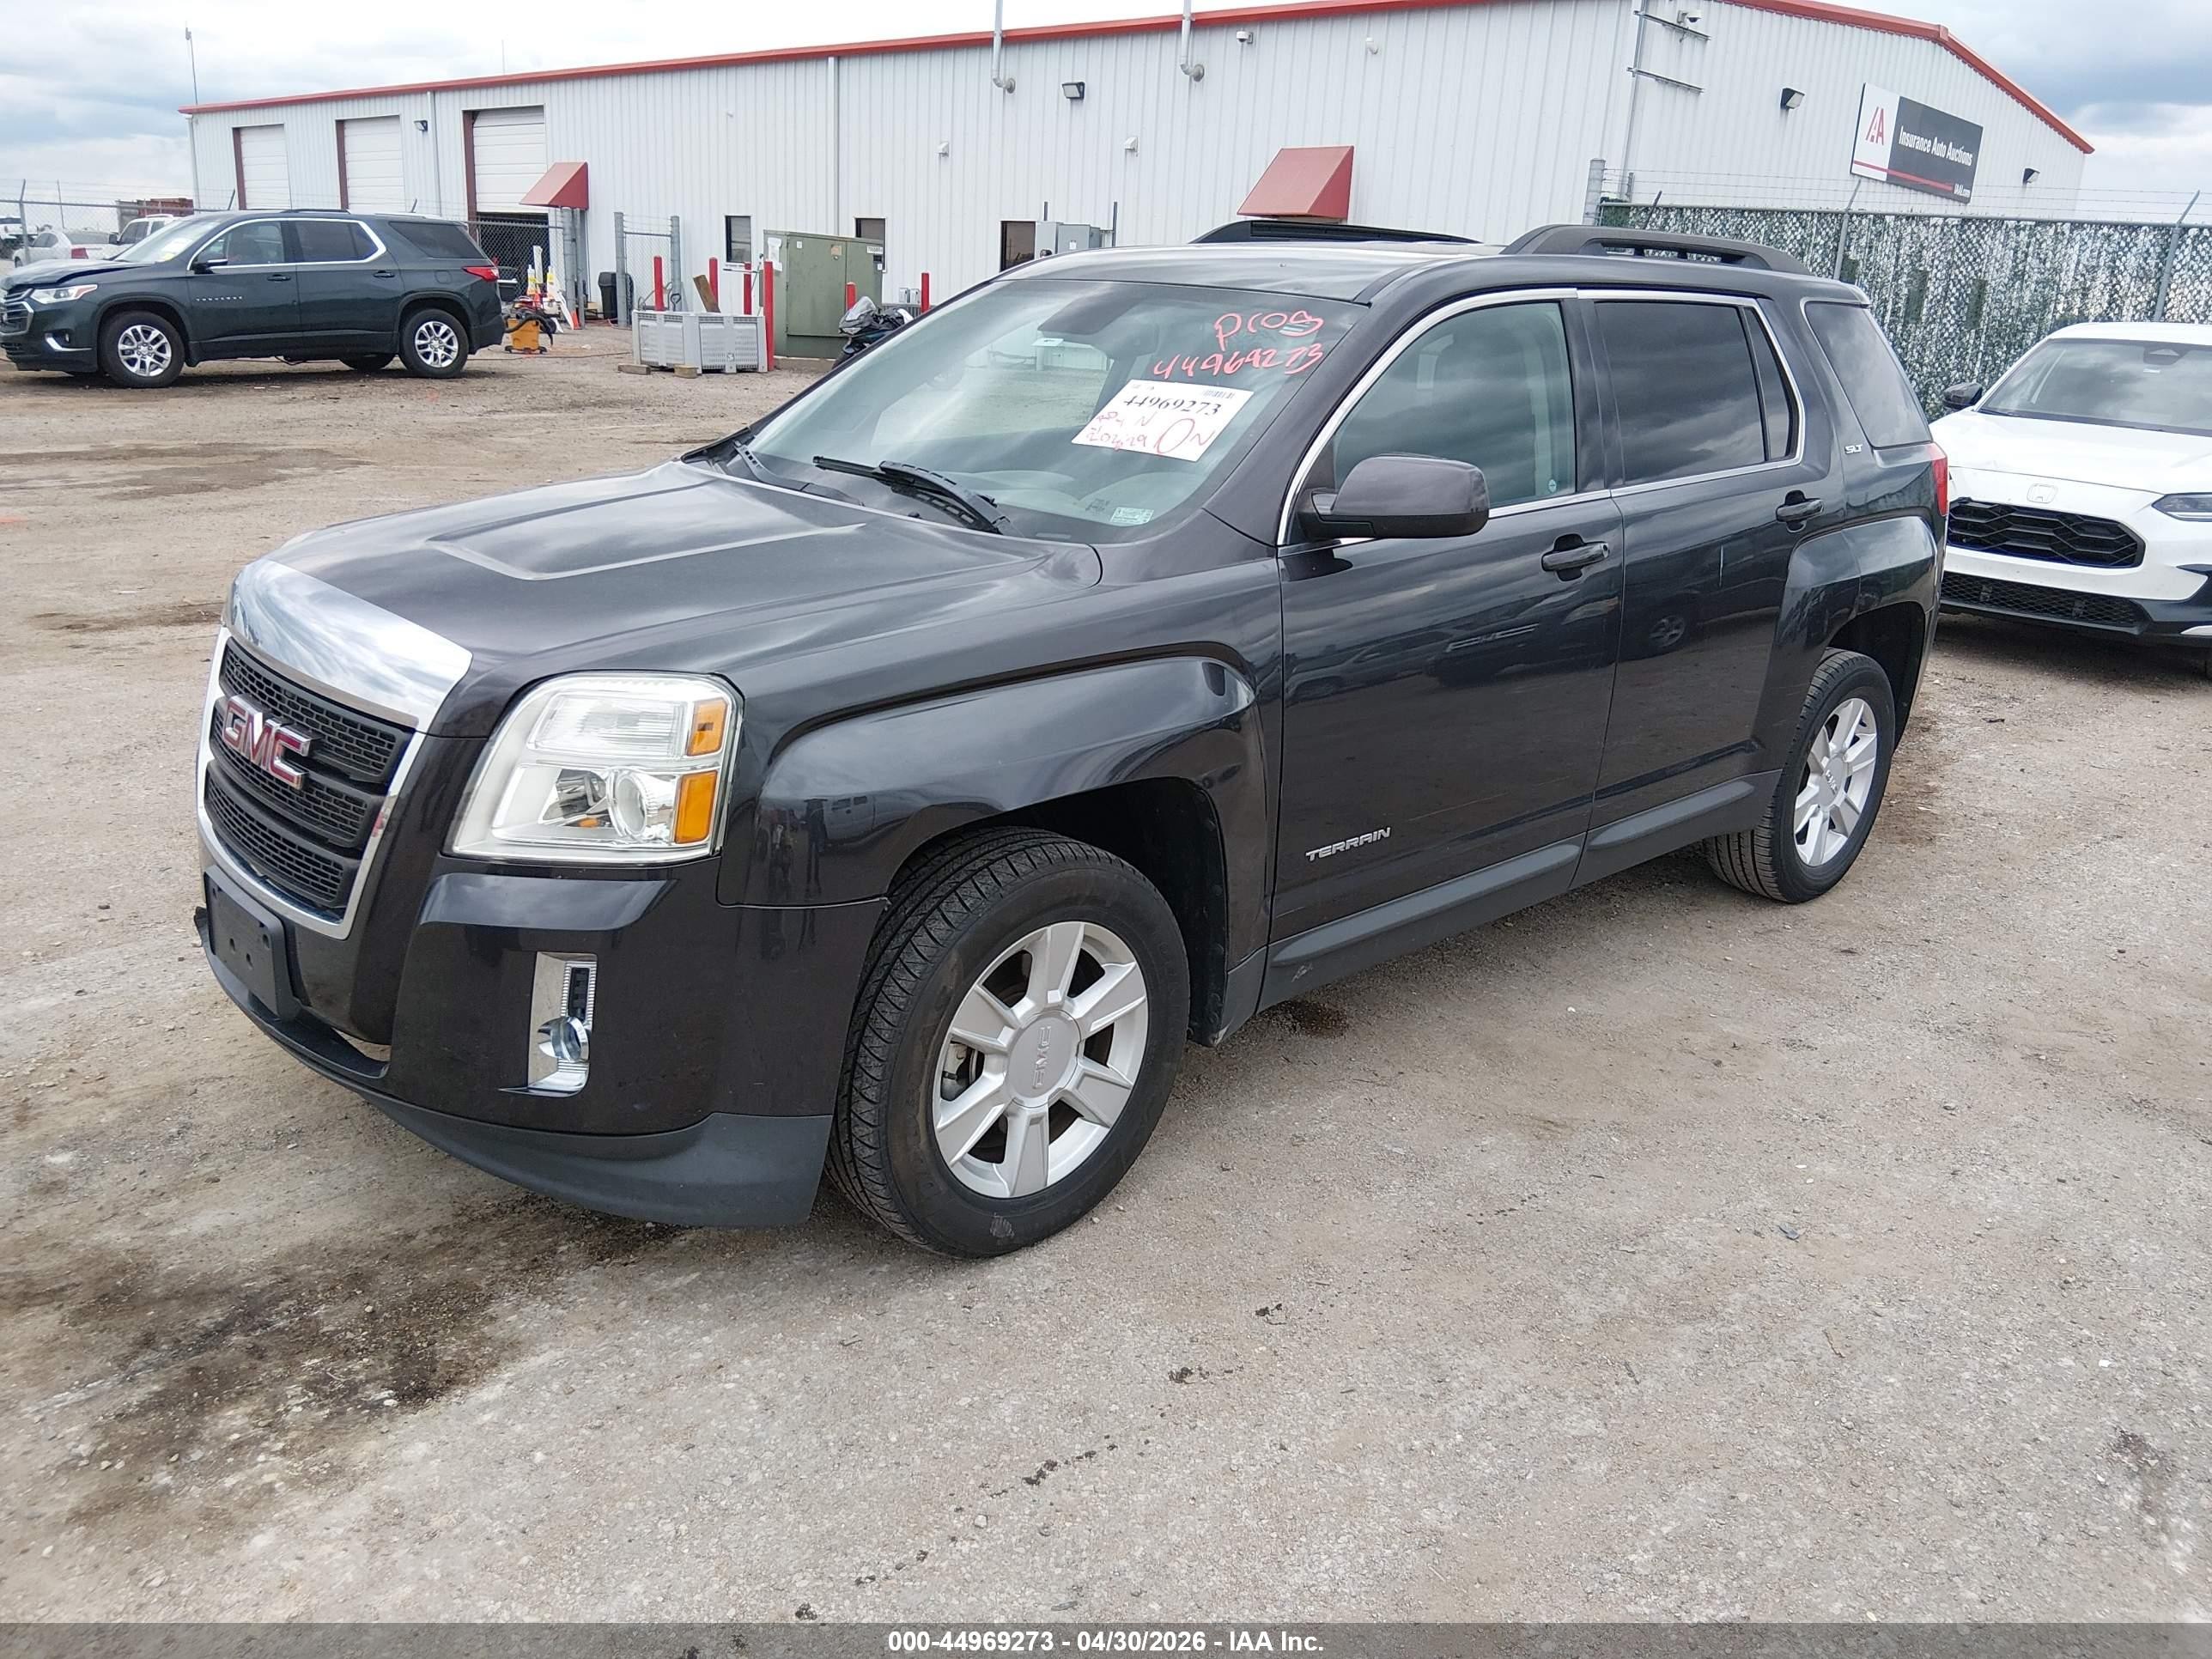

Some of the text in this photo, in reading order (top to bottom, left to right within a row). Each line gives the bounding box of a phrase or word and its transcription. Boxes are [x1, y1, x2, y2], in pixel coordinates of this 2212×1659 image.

[1898, 125, 1973, 167] Insurance Auto Auctions
[1153, 343, 1324, 380] 44969273
[1123, 394, 1222, 416] 44969273
[223, 696, 311, 790] GMC
[1305, 826, 1391, 862] TERRAIN
[1032, 1025, 1053, 1090] GMC
